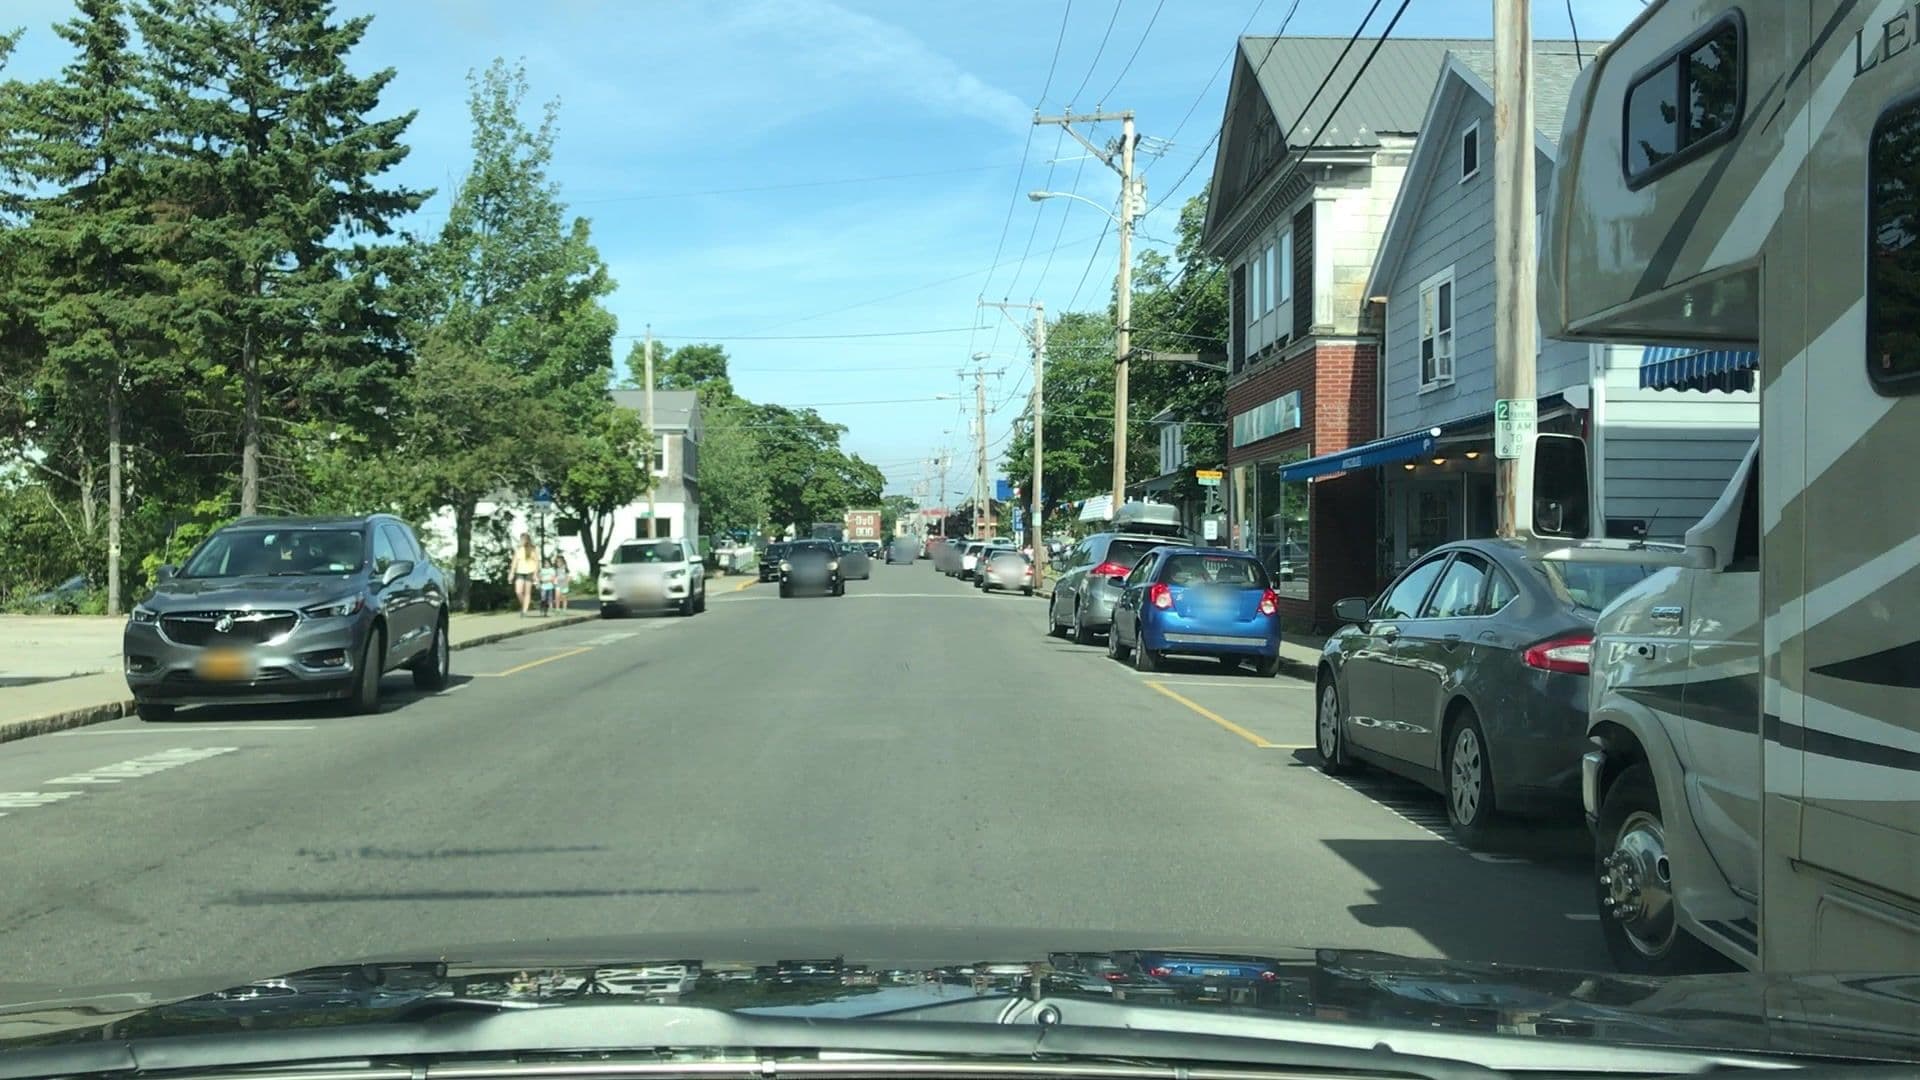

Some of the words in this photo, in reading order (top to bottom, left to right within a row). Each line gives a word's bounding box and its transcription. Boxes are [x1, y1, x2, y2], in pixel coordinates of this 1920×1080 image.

[1853, 1, 1920, 78] LE
[1499, 404, 1508, 418] 2
[1501, 422, 1512, 431] 10
[1517, 422, 1532, 430] AM
